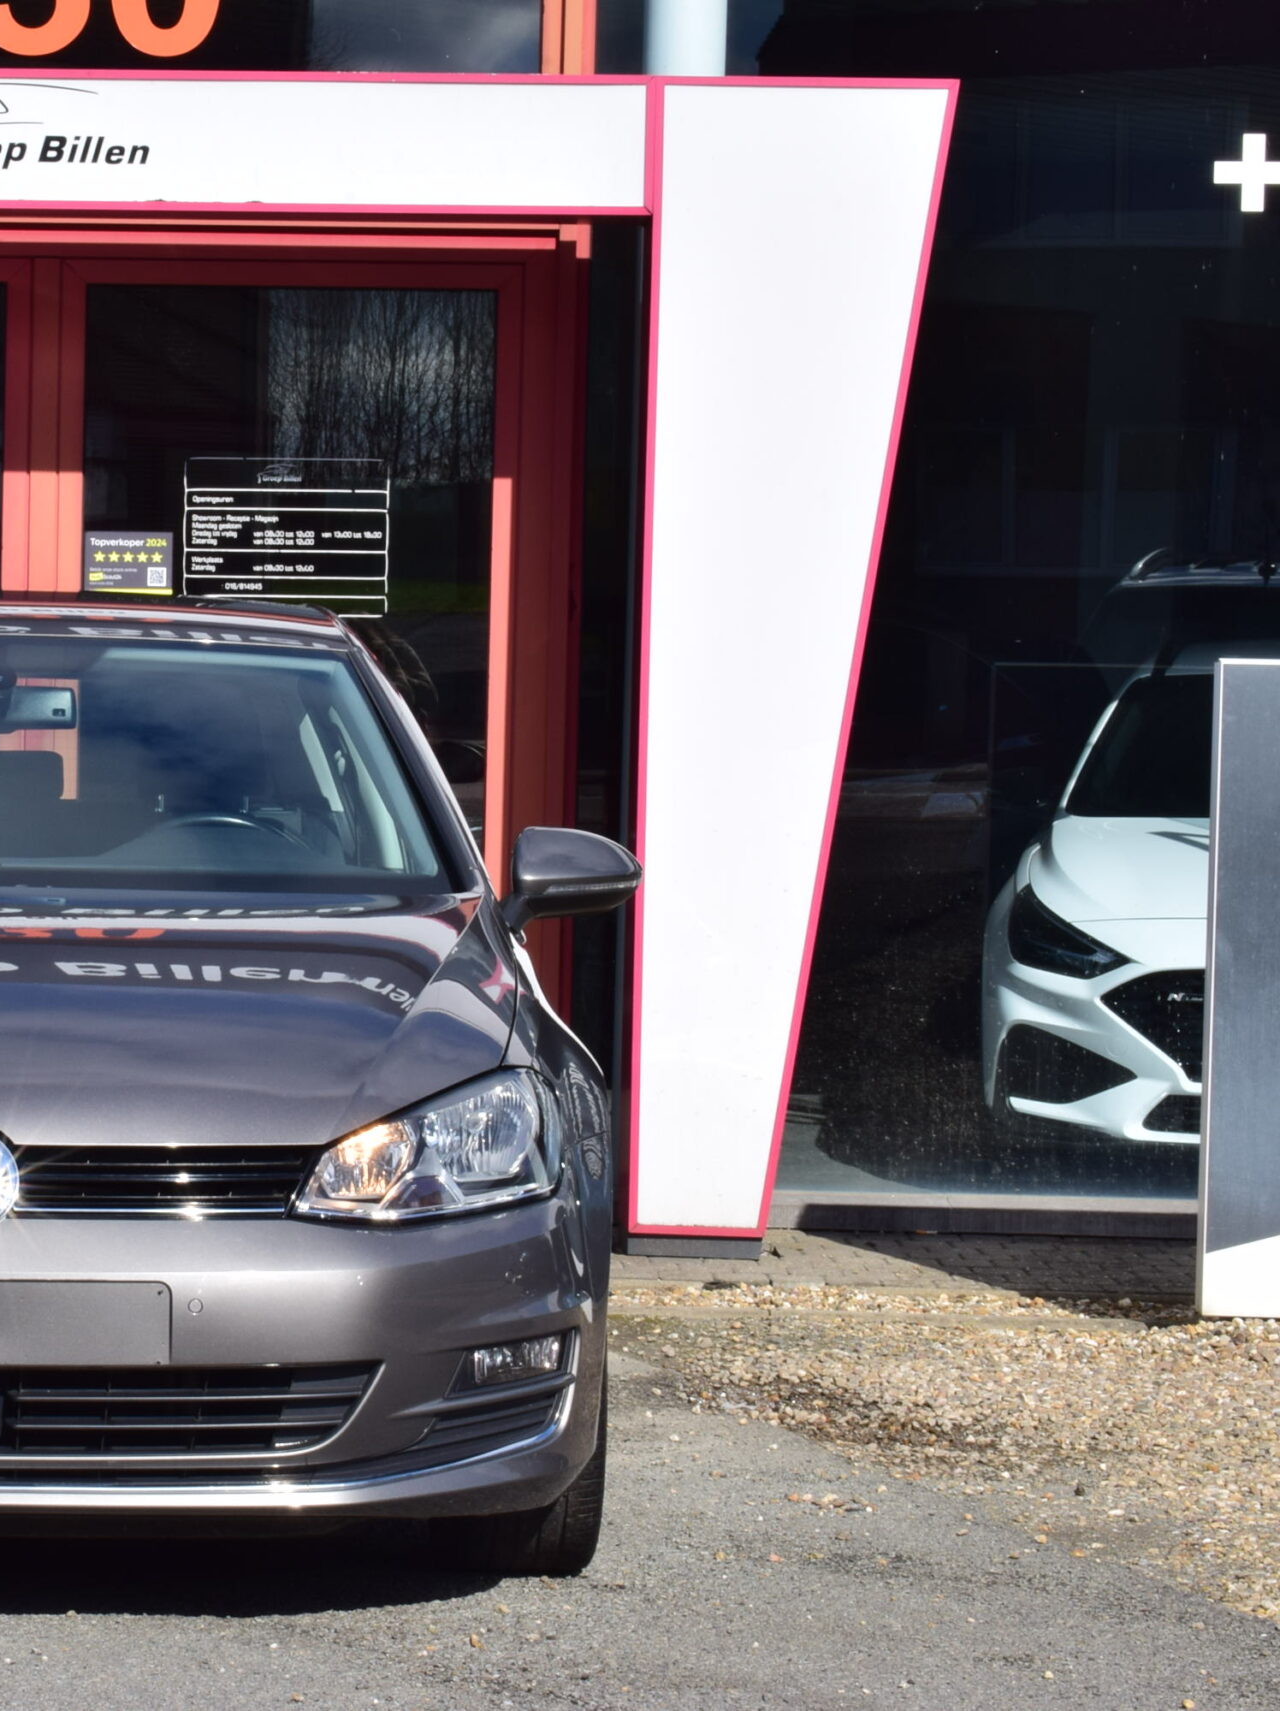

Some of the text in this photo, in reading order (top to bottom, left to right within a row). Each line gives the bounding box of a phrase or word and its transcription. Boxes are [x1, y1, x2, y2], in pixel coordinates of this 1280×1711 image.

[38, 135, 151, 166] Billen
[192, 494, 235, 505] Openingsuren
[191, 513, 222, 522] Showroom
[191, 522, 218, 531] Maandag
[89, 537, 168, 549] Topverkoper 2024
[191, 537, 218, 546] Zaterdag
